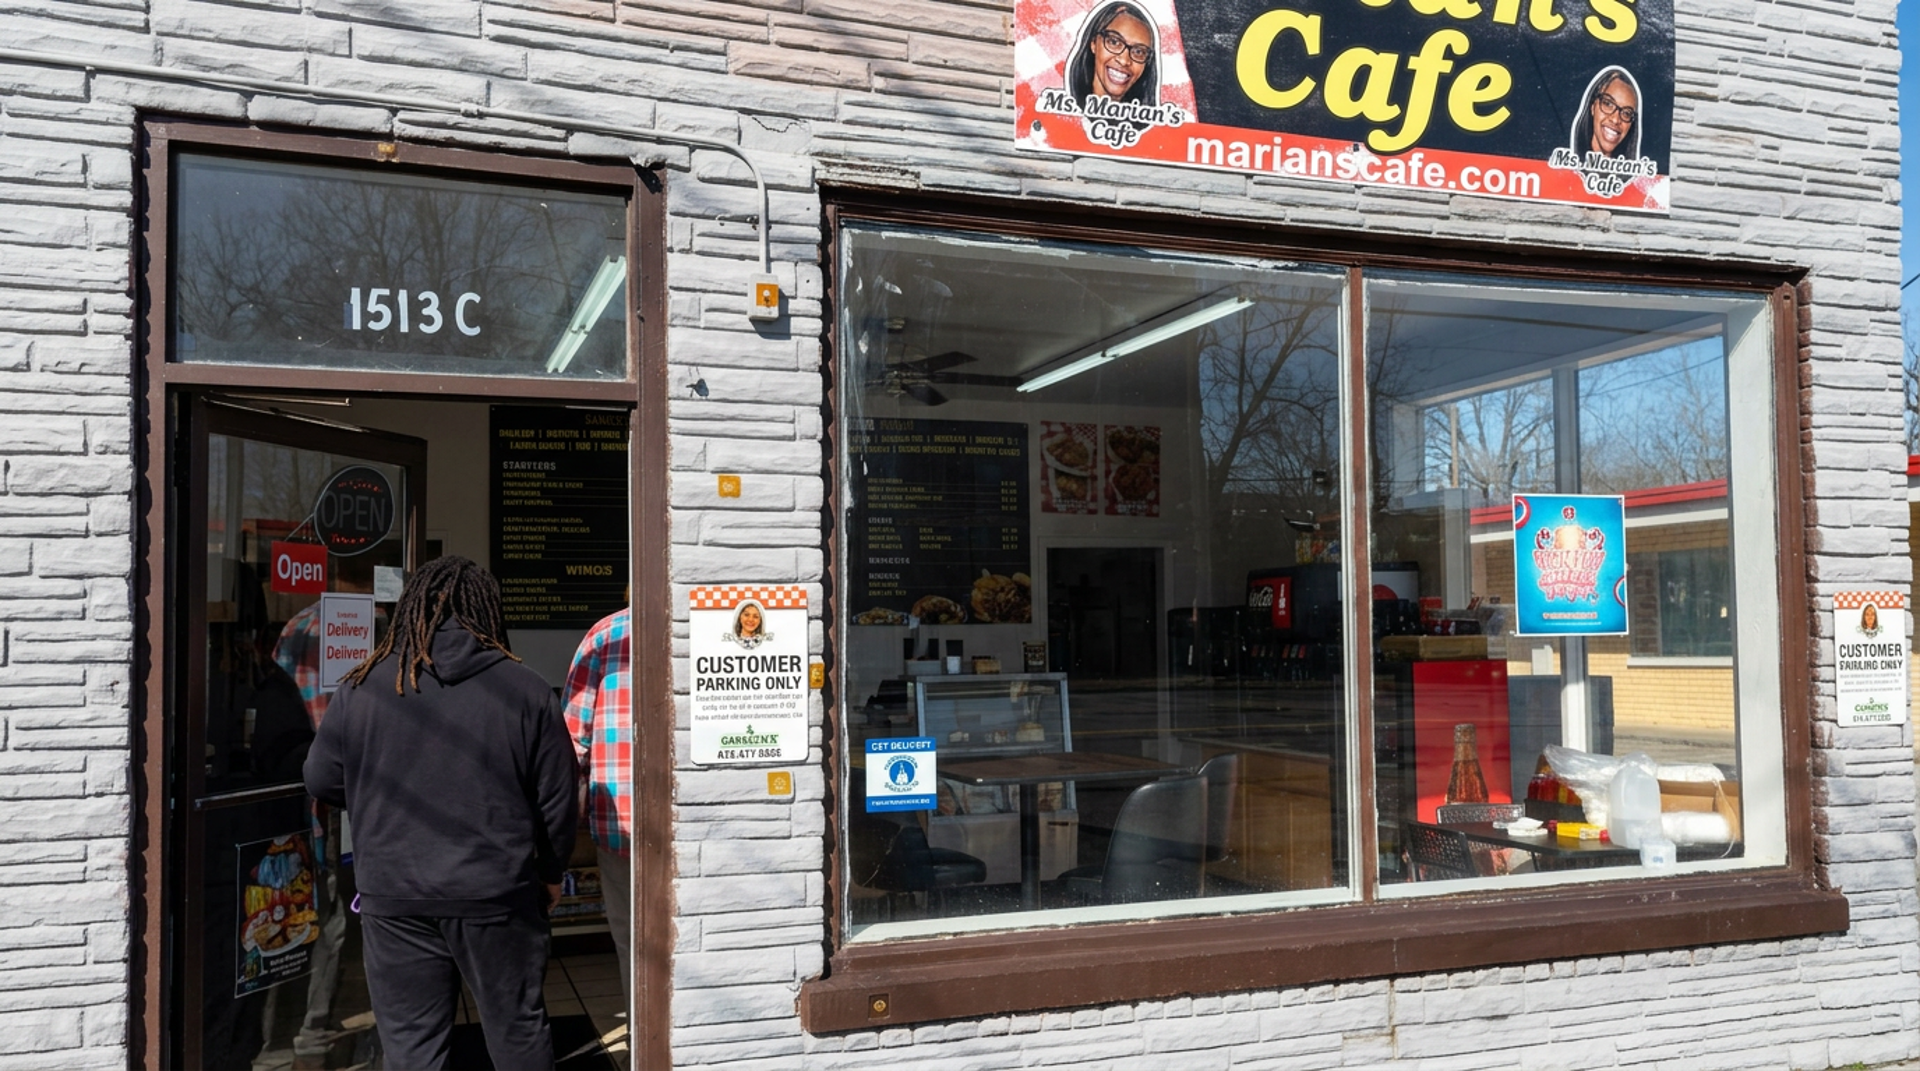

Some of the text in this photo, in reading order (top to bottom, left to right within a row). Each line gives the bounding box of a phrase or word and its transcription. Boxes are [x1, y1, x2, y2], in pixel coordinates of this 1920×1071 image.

[1236, 10, 1513, 152] Cafe
[1043, 91, 1182, 125] Ms. Marian's
[1090, 121, 1137, 147] Cafe
[1186, 136, 1541, 197] marianscafe.com
[1586, 173, 1623, 196] Cafe
[350, 286, 482, 337] 1513 C
[320, 490, 386, 534] OPEN
[276, 553, 323, 586] Open
[327, 621, 369, 640] Delivery
[696, 654, 802, 674] CUSTOMER
[1839, 643, 1902, 658] CUSTOMER
[696, 675, 802, 692] PARKING ONLY
